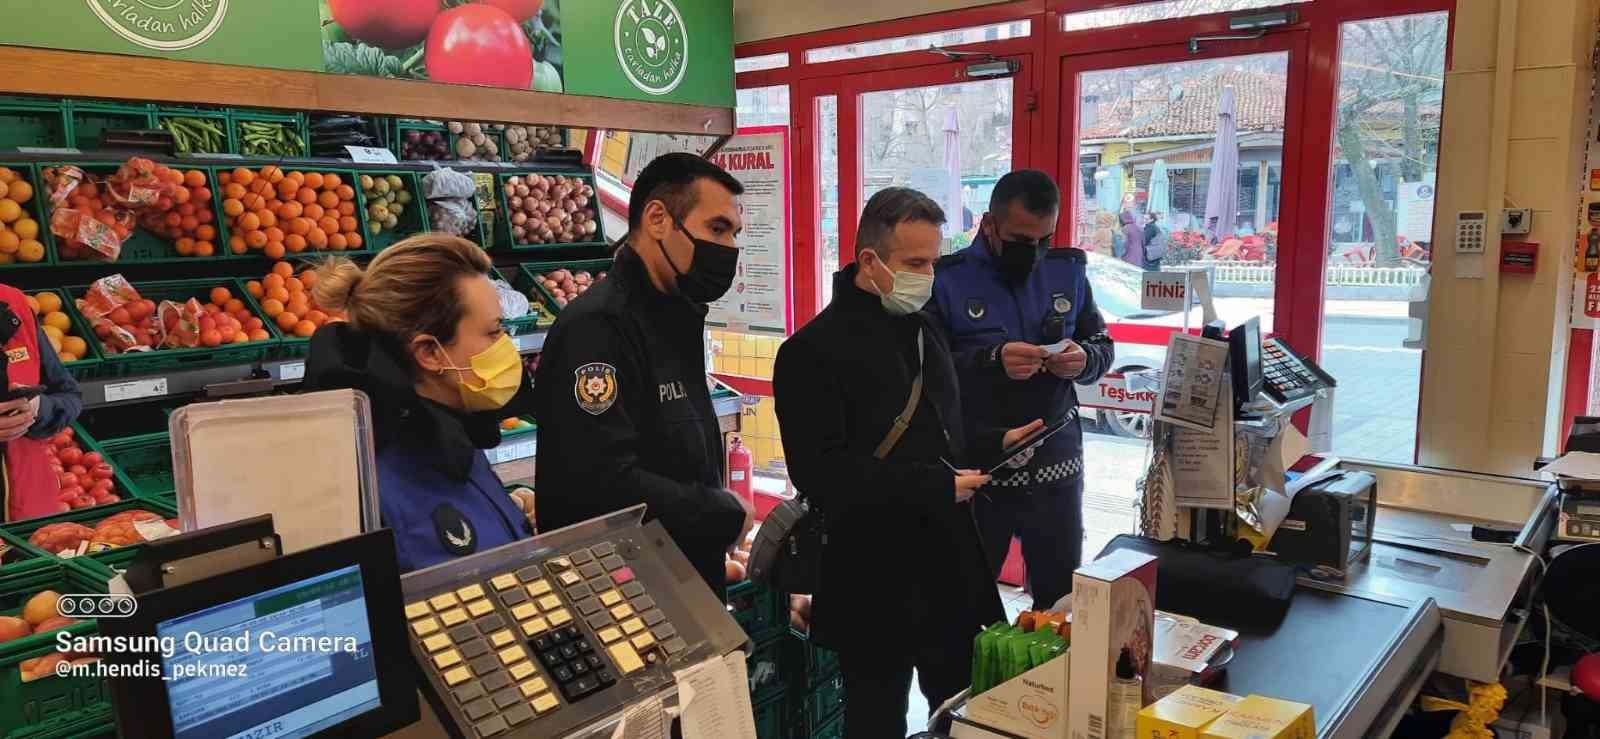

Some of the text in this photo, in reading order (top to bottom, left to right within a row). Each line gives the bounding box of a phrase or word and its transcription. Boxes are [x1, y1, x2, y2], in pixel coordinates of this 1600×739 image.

[178, 0, 214, 31] halk
[626, 0, 677, 30] TAZE
[728, 152, 774, 170] KURAL
